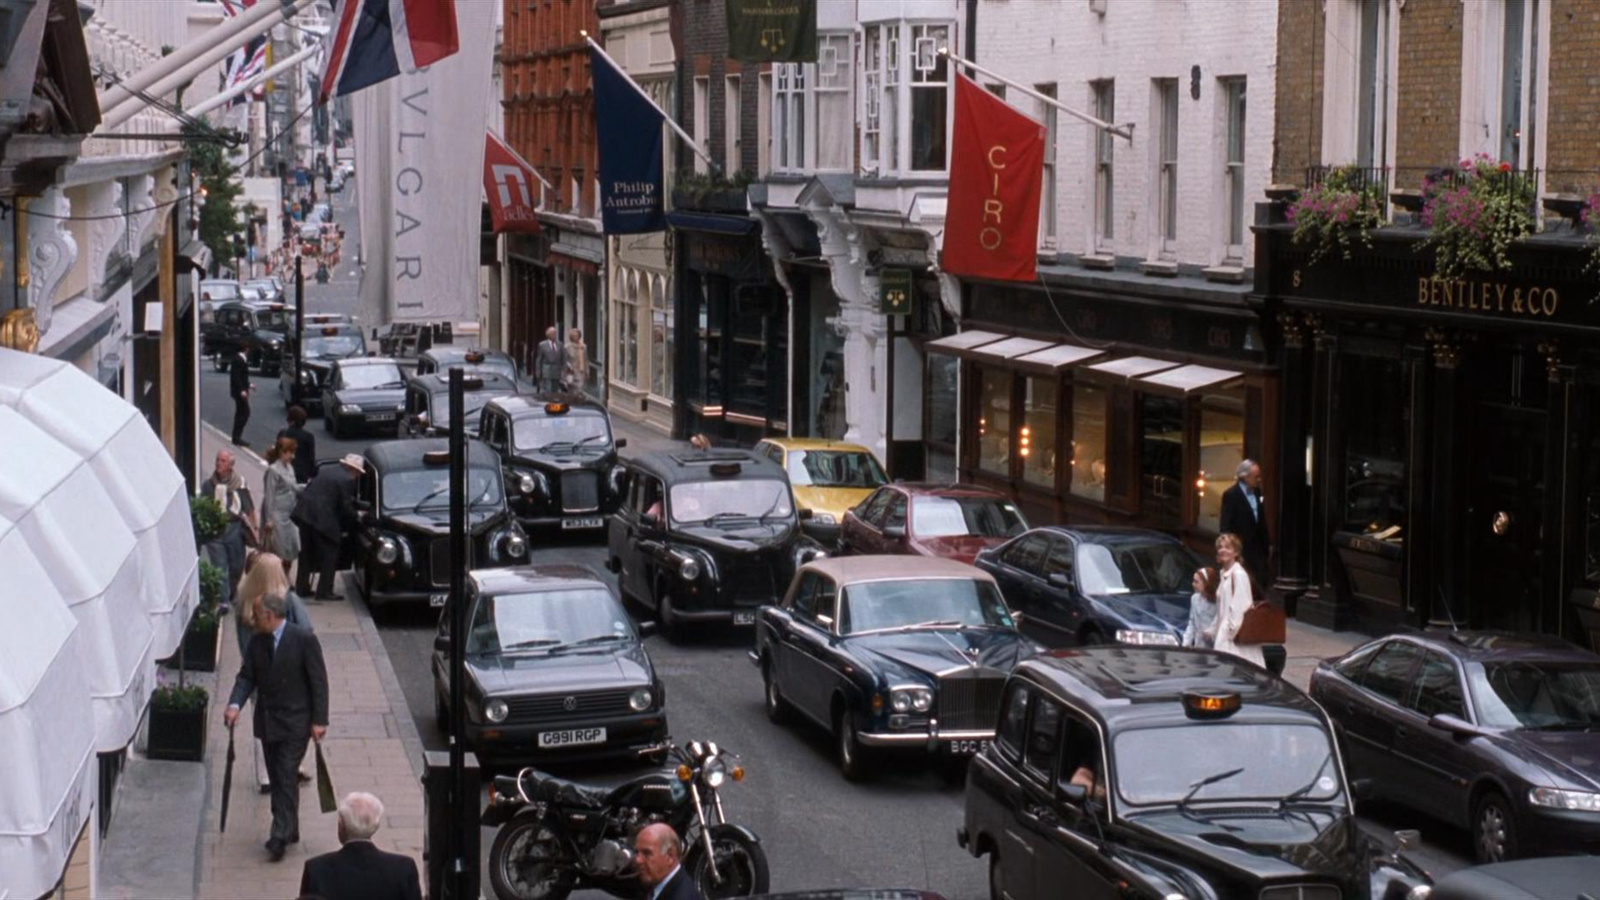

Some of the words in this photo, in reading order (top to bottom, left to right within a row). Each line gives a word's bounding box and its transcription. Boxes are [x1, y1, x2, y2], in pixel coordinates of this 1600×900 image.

[614, 182, 655, 195] Philip
[605, 195, 659, 207] Antrobu
[980, 146, 1007, 250] CIRO
